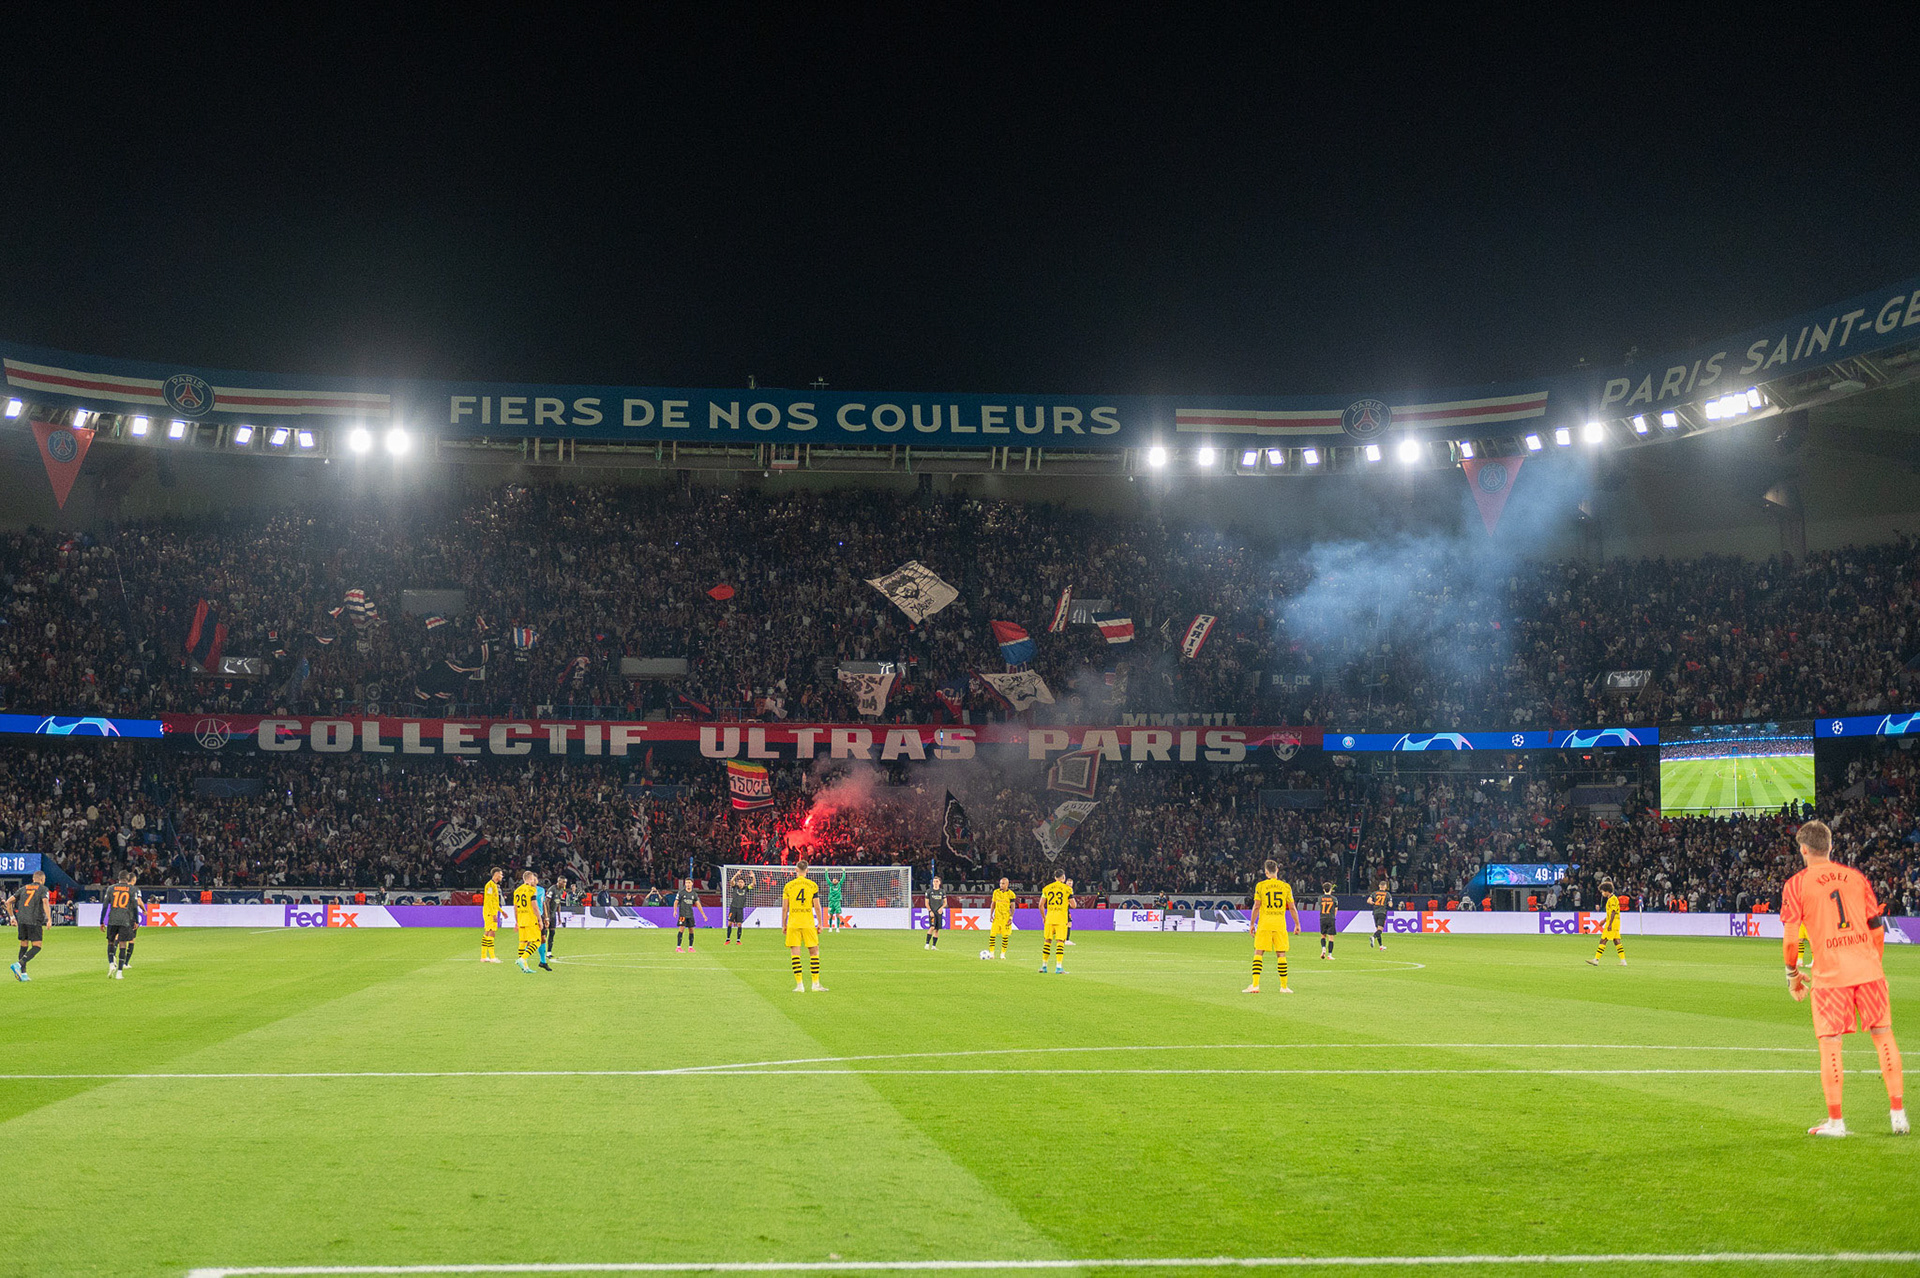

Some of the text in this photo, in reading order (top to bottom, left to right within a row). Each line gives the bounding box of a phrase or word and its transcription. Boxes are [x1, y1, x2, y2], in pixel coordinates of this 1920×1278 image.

[171, 376, 204, 388] PARIS
[1600, 351, 1727, 409] PARIS
[1351, 401, 1383, 412] PARIS
[450, 396, 1121, 435] FIERS DE NOS COULEURS
[258, 719, 1247, 762] COLLECTIF ULTRAS PARIS
[1535, 868, 1565, 880] 49:16
[1818, 872, 1848, 886] KOBEL
[24, 890, 35, 906] 7
[113, 891, 130, 908] 10
[516, 893, 528, 908] 26
[796, 888, 806, 903] 4
[1048, 891, 1064, 905] 23
[1265, 892, 1283, 908] 15
[1375, 895, 1386, 906] 21
[1321, 901, 1334, 914] 17
[1830, 889, 1850, 929] 1
[284, 904, 359, 927] FedEx
[1132, 911, 1159, 922] FedEx
[1383, 911, 1451, 933] FedEx
[1539, 912, 1606, 934] FedEx
[1730, 914, 1760, 936] FedEx
[1826, 933, 1868, 948] DORTMUND
